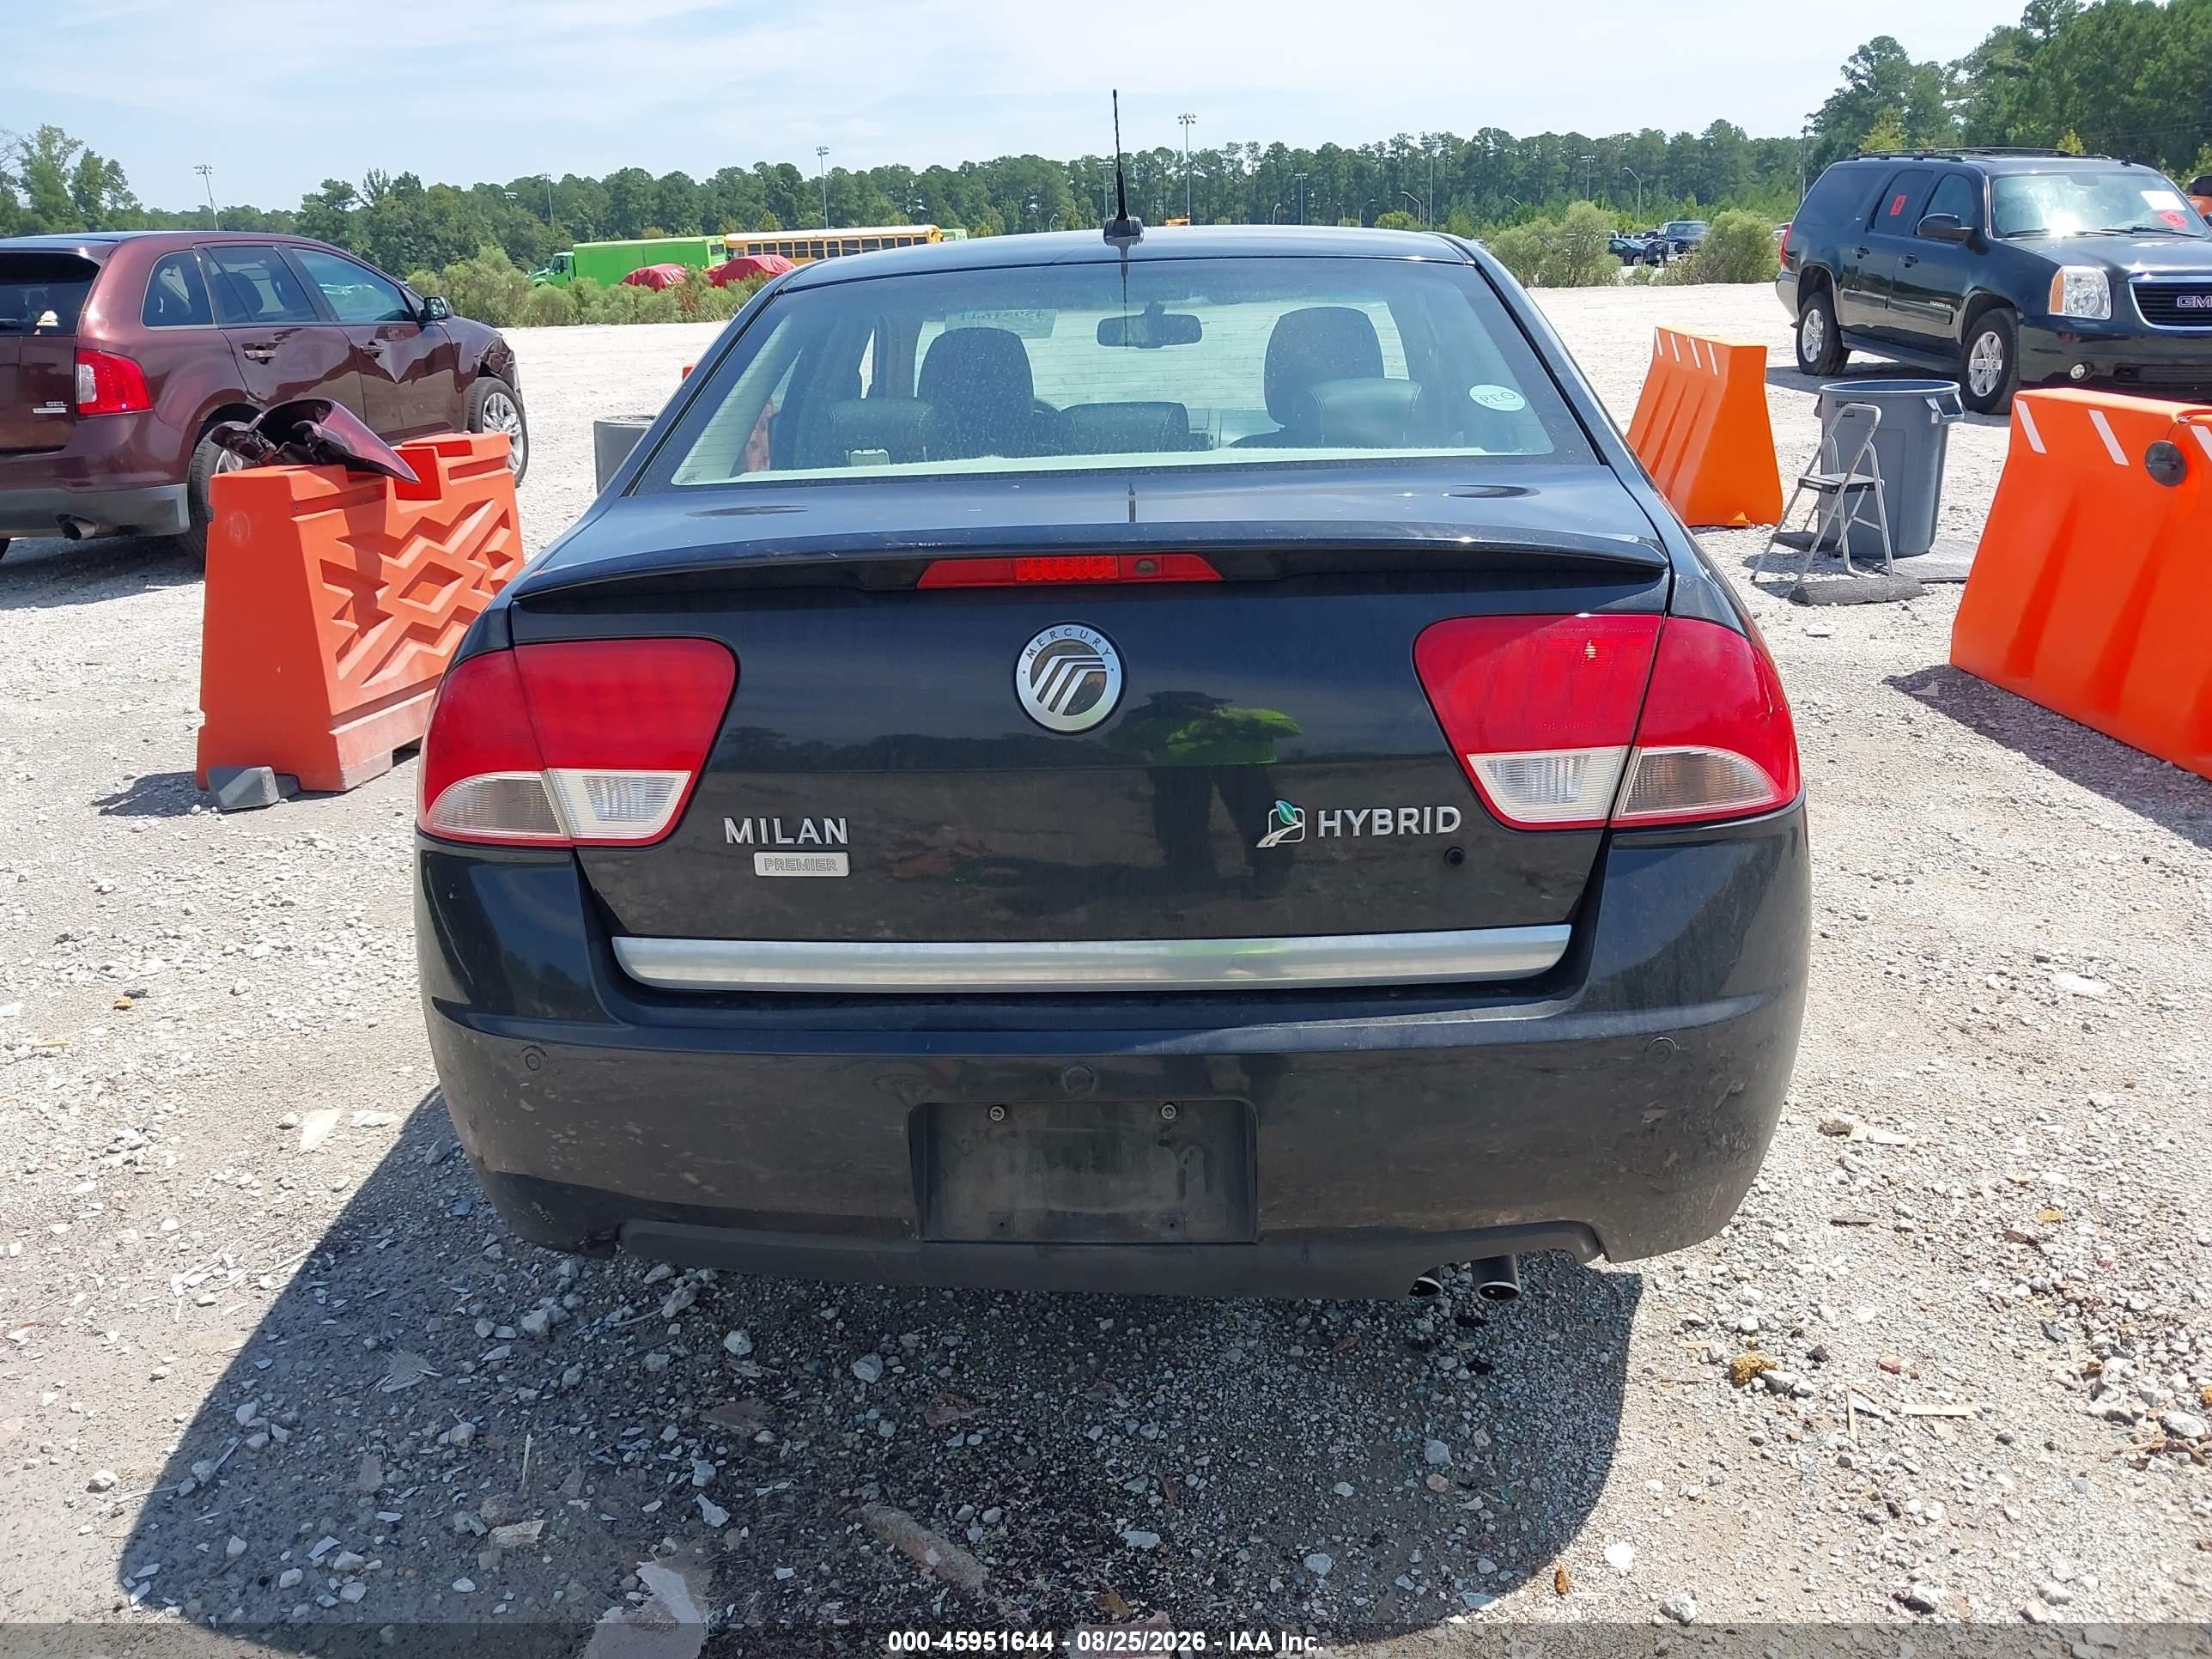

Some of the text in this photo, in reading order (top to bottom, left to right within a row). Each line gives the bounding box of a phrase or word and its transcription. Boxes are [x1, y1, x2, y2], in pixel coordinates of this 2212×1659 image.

[2177, 295, 2212, 307] GM
[1026, 628, 1111, 659] MERCURY
[724, 817, 848, 844] MILAN
[1317, 805, 1462, 838] HYBRID
[764, 858, 837, 872] PREMIER
